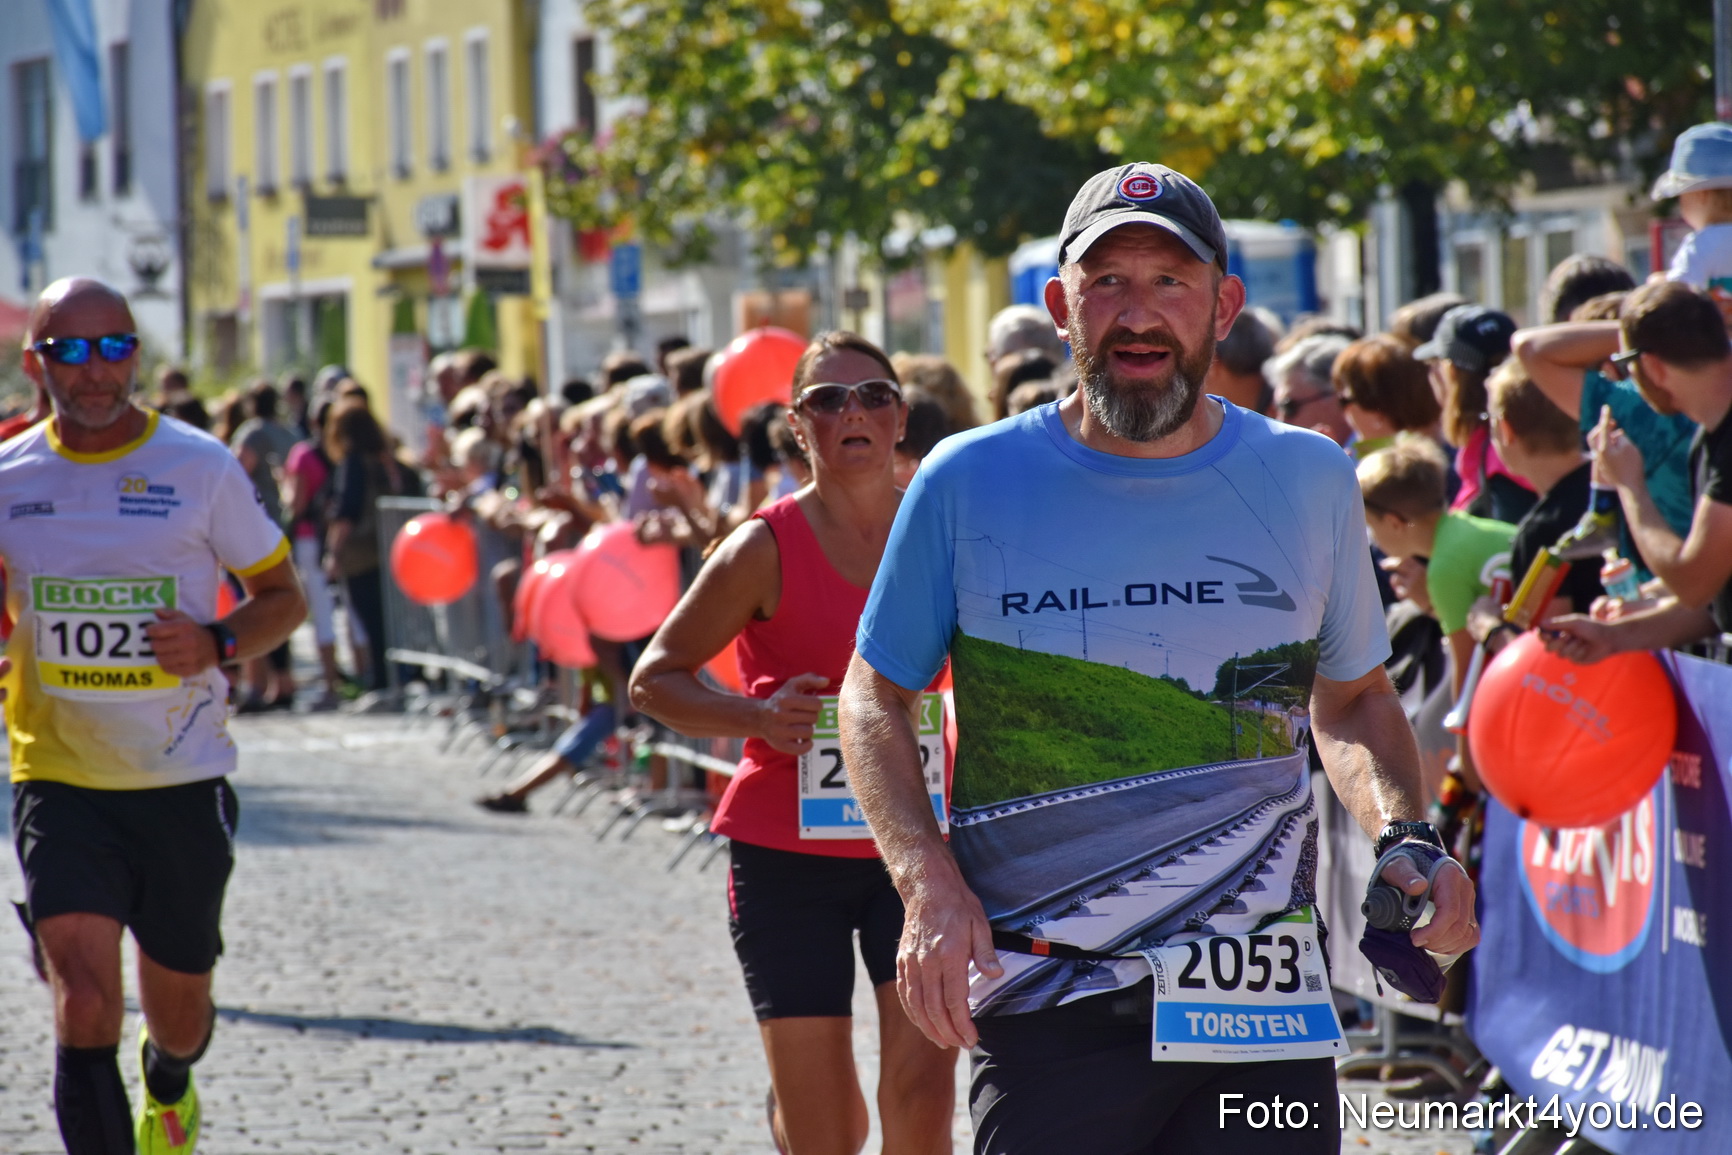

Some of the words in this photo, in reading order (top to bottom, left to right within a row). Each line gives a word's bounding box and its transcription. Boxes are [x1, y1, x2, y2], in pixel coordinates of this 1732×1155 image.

[121, 477, 147, 493] 20
[43, 582, 165, 609] BOCK
[1002, 581, 1224, 616] RAIL.ONE
[60, 671, 153, 687] THOMAS
[1305, 941, 1311, 951] D
[1178, 935, 1300, 994] 2053
[1185, 1012, 1309, 1038] TORSTEN
[1530, 1023, 1611, 1091] GET
